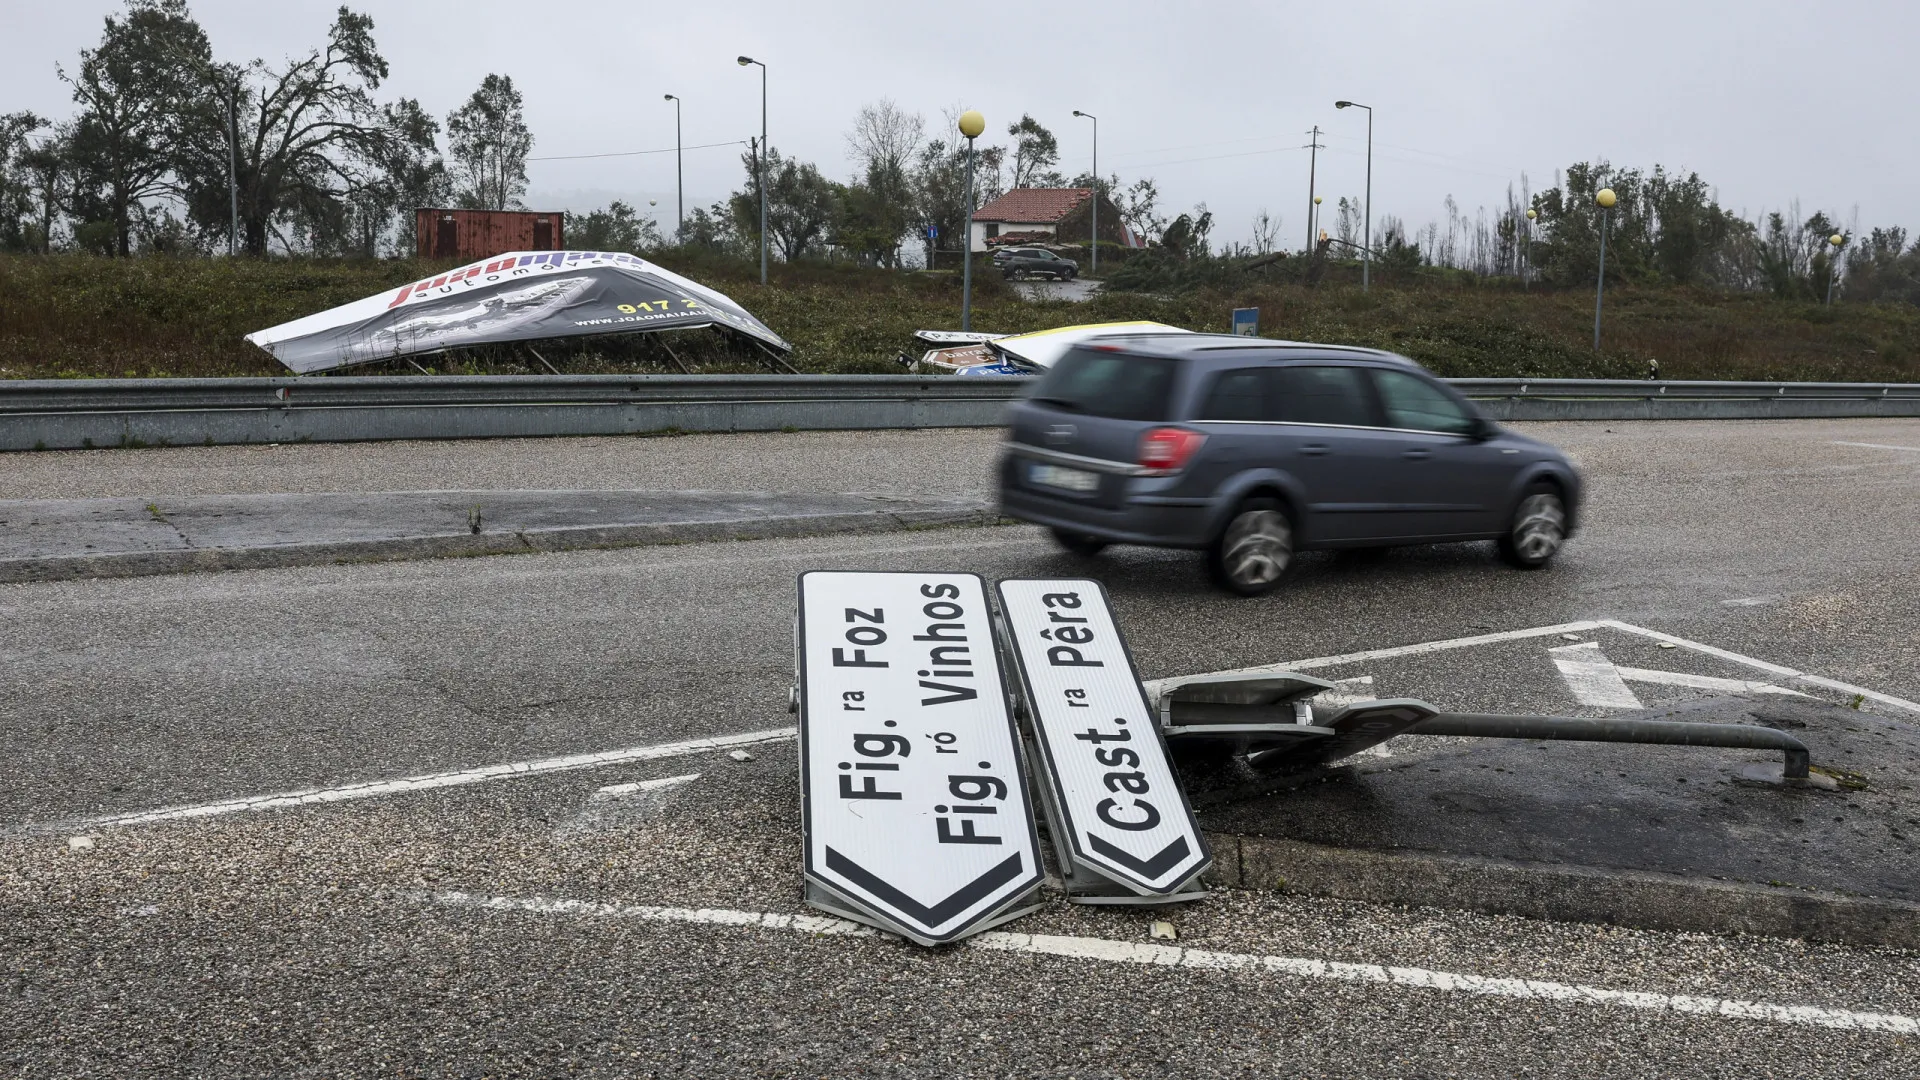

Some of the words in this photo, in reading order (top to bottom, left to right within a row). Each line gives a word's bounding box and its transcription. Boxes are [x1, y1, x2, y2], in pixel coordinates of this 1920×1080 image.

[616, 299, 670, 315] 917
[832, 607, 890, 668] Foz
[912, 583, 978, 707] Vinhos
[1040, 591, 1106, 668] Pêra
[842, 690, 866, 711] ra
[1064, 687, 1090, 709] ra
[838, 720, 911, 801] Fig.
[926, 730, 959, 755] ró
[1073, 716, 1162, 832] Cast.
[934, 760, 1008, 846] Fig.
